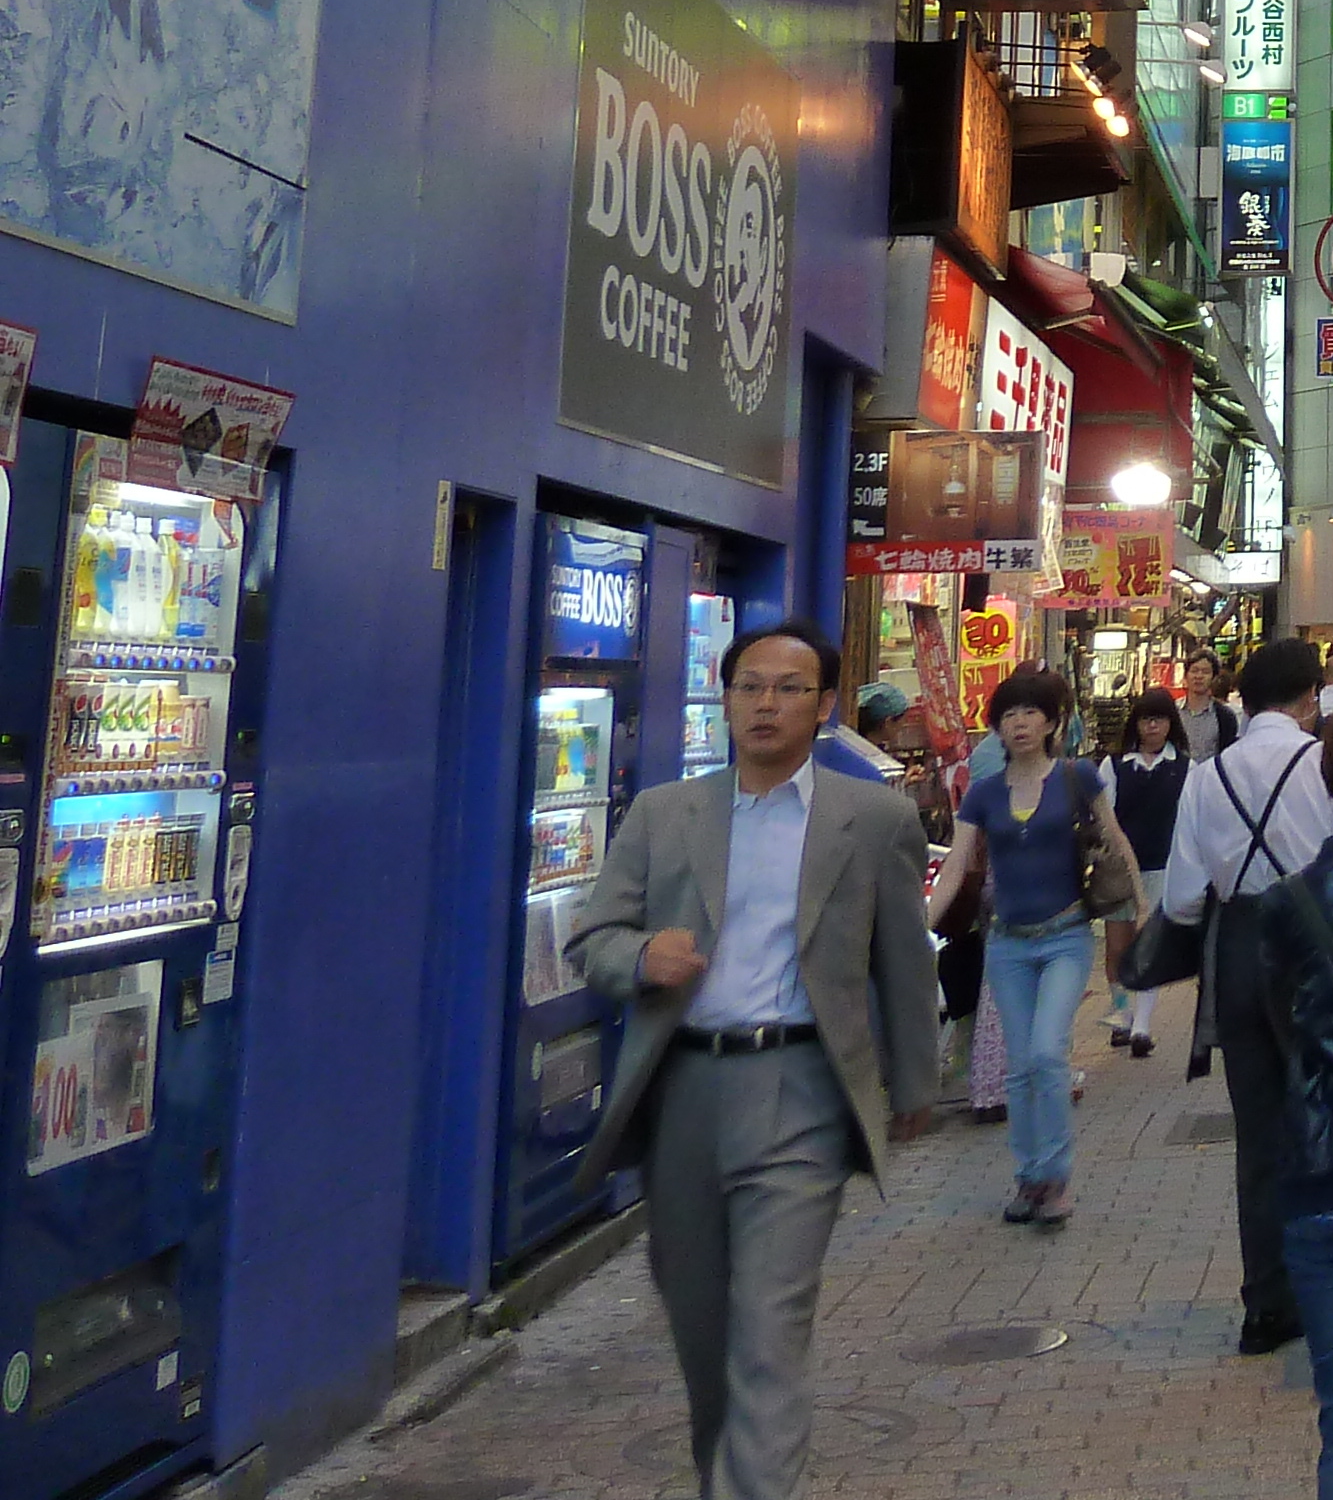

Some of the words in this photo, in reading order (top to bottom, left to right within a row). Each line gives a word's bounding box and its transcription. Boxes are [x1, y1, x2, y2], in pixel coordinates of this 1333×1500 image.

[1233, 96, 1255, 116] B1
[587, 66, 712, 289] BOSS
[600, 264, 691, 373] COFFEE
[853, 486, 889, 508] 50席
[874, 548, 984, 571] 七輪焼肉
[984, 545, 1036, 570] 牛繁
[550, 590, 582, 620] COFFEE
[580, 568, 623, 628] BOSS
[963, 612, 1009, 650] 30
